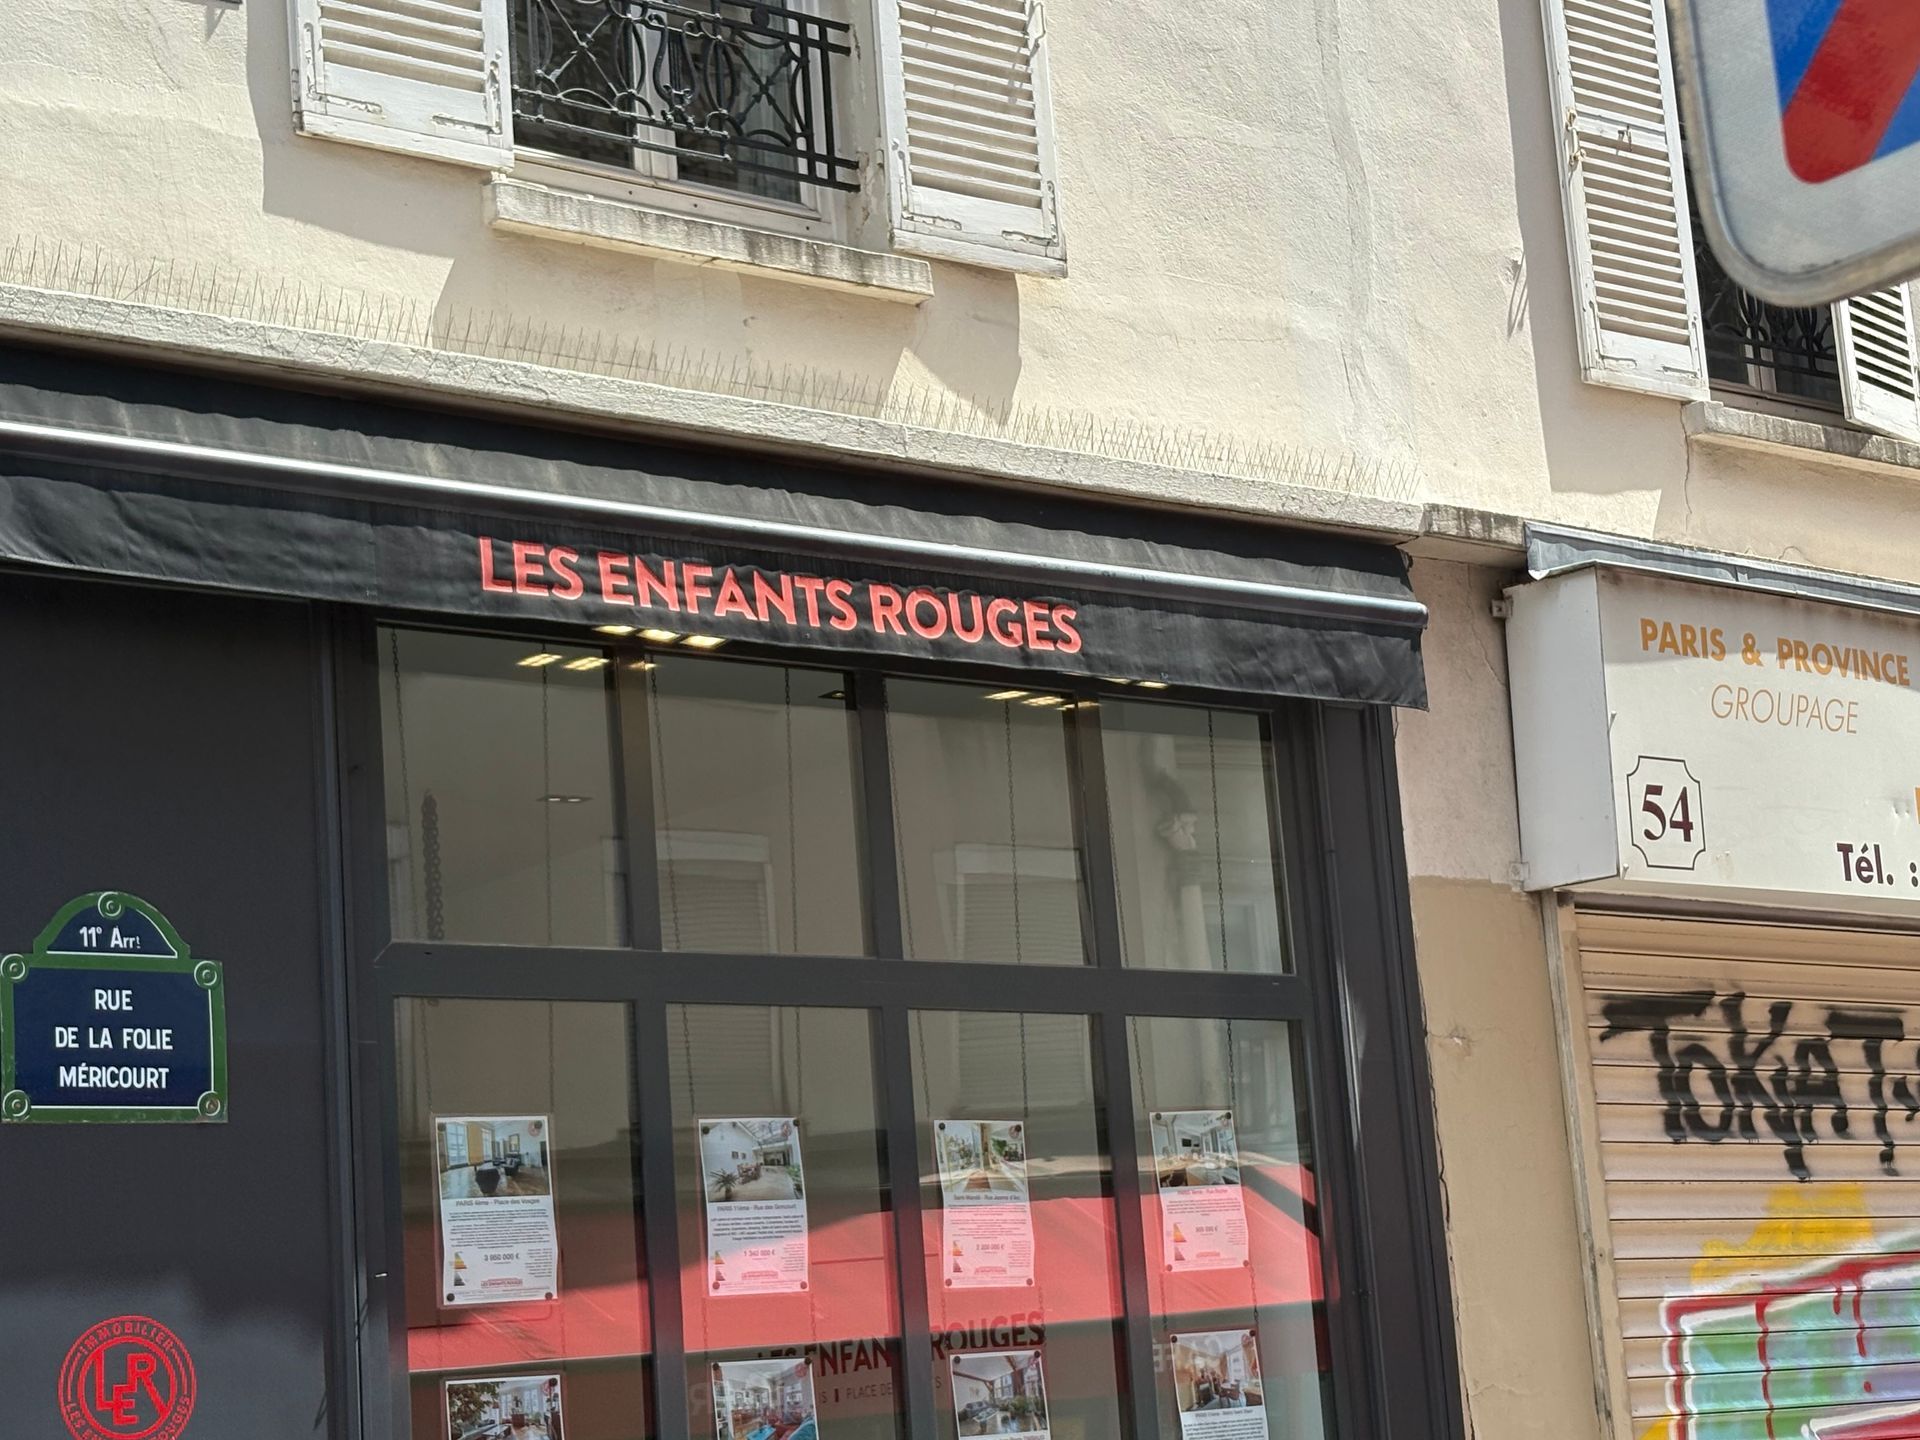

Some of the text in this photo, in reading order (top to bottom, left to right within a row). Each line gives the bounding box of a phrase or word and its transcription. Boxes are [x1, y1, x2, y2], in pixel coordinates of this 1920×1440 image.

[478, 535, 1083, 654] LES ENFANTS ROUGES
[1640, 618, 1911, 687] PARIS & PROVINCE
[1711, 684, 1859, 735] GROUPAGE
[1641, 783, 1694, 842] 54
[1836, 842, 1894, 886] Tél.
[94, 988, 133, 1011] RUE
[54, 1026, 173, 1050] DE LA FOLIE
[59, 1063, 169, 1089] MÉRICOURT
[931, 1310, 1046, 1361] ROUGES
